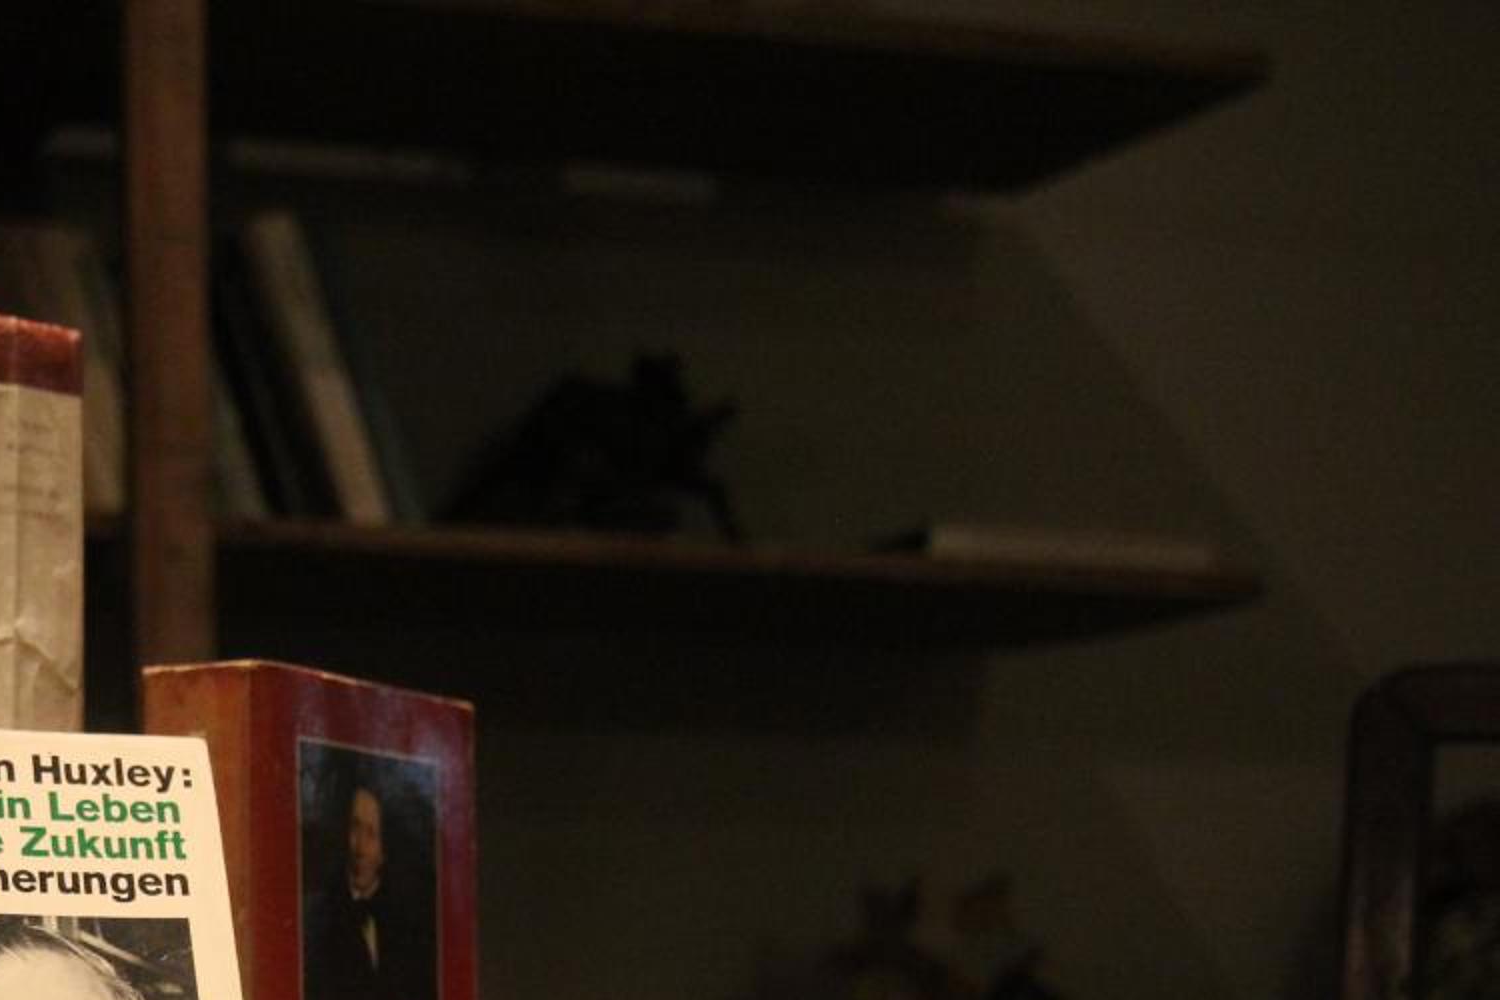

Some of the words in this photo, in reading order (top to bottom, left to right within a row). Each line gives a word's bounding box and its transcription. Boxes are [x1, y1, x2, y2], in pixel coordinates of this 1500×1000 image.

[32, 755, 191, 793] Huxley:
[49, 792, 180, 823] Leben
[19, 826, 187, 860] Zukunft
